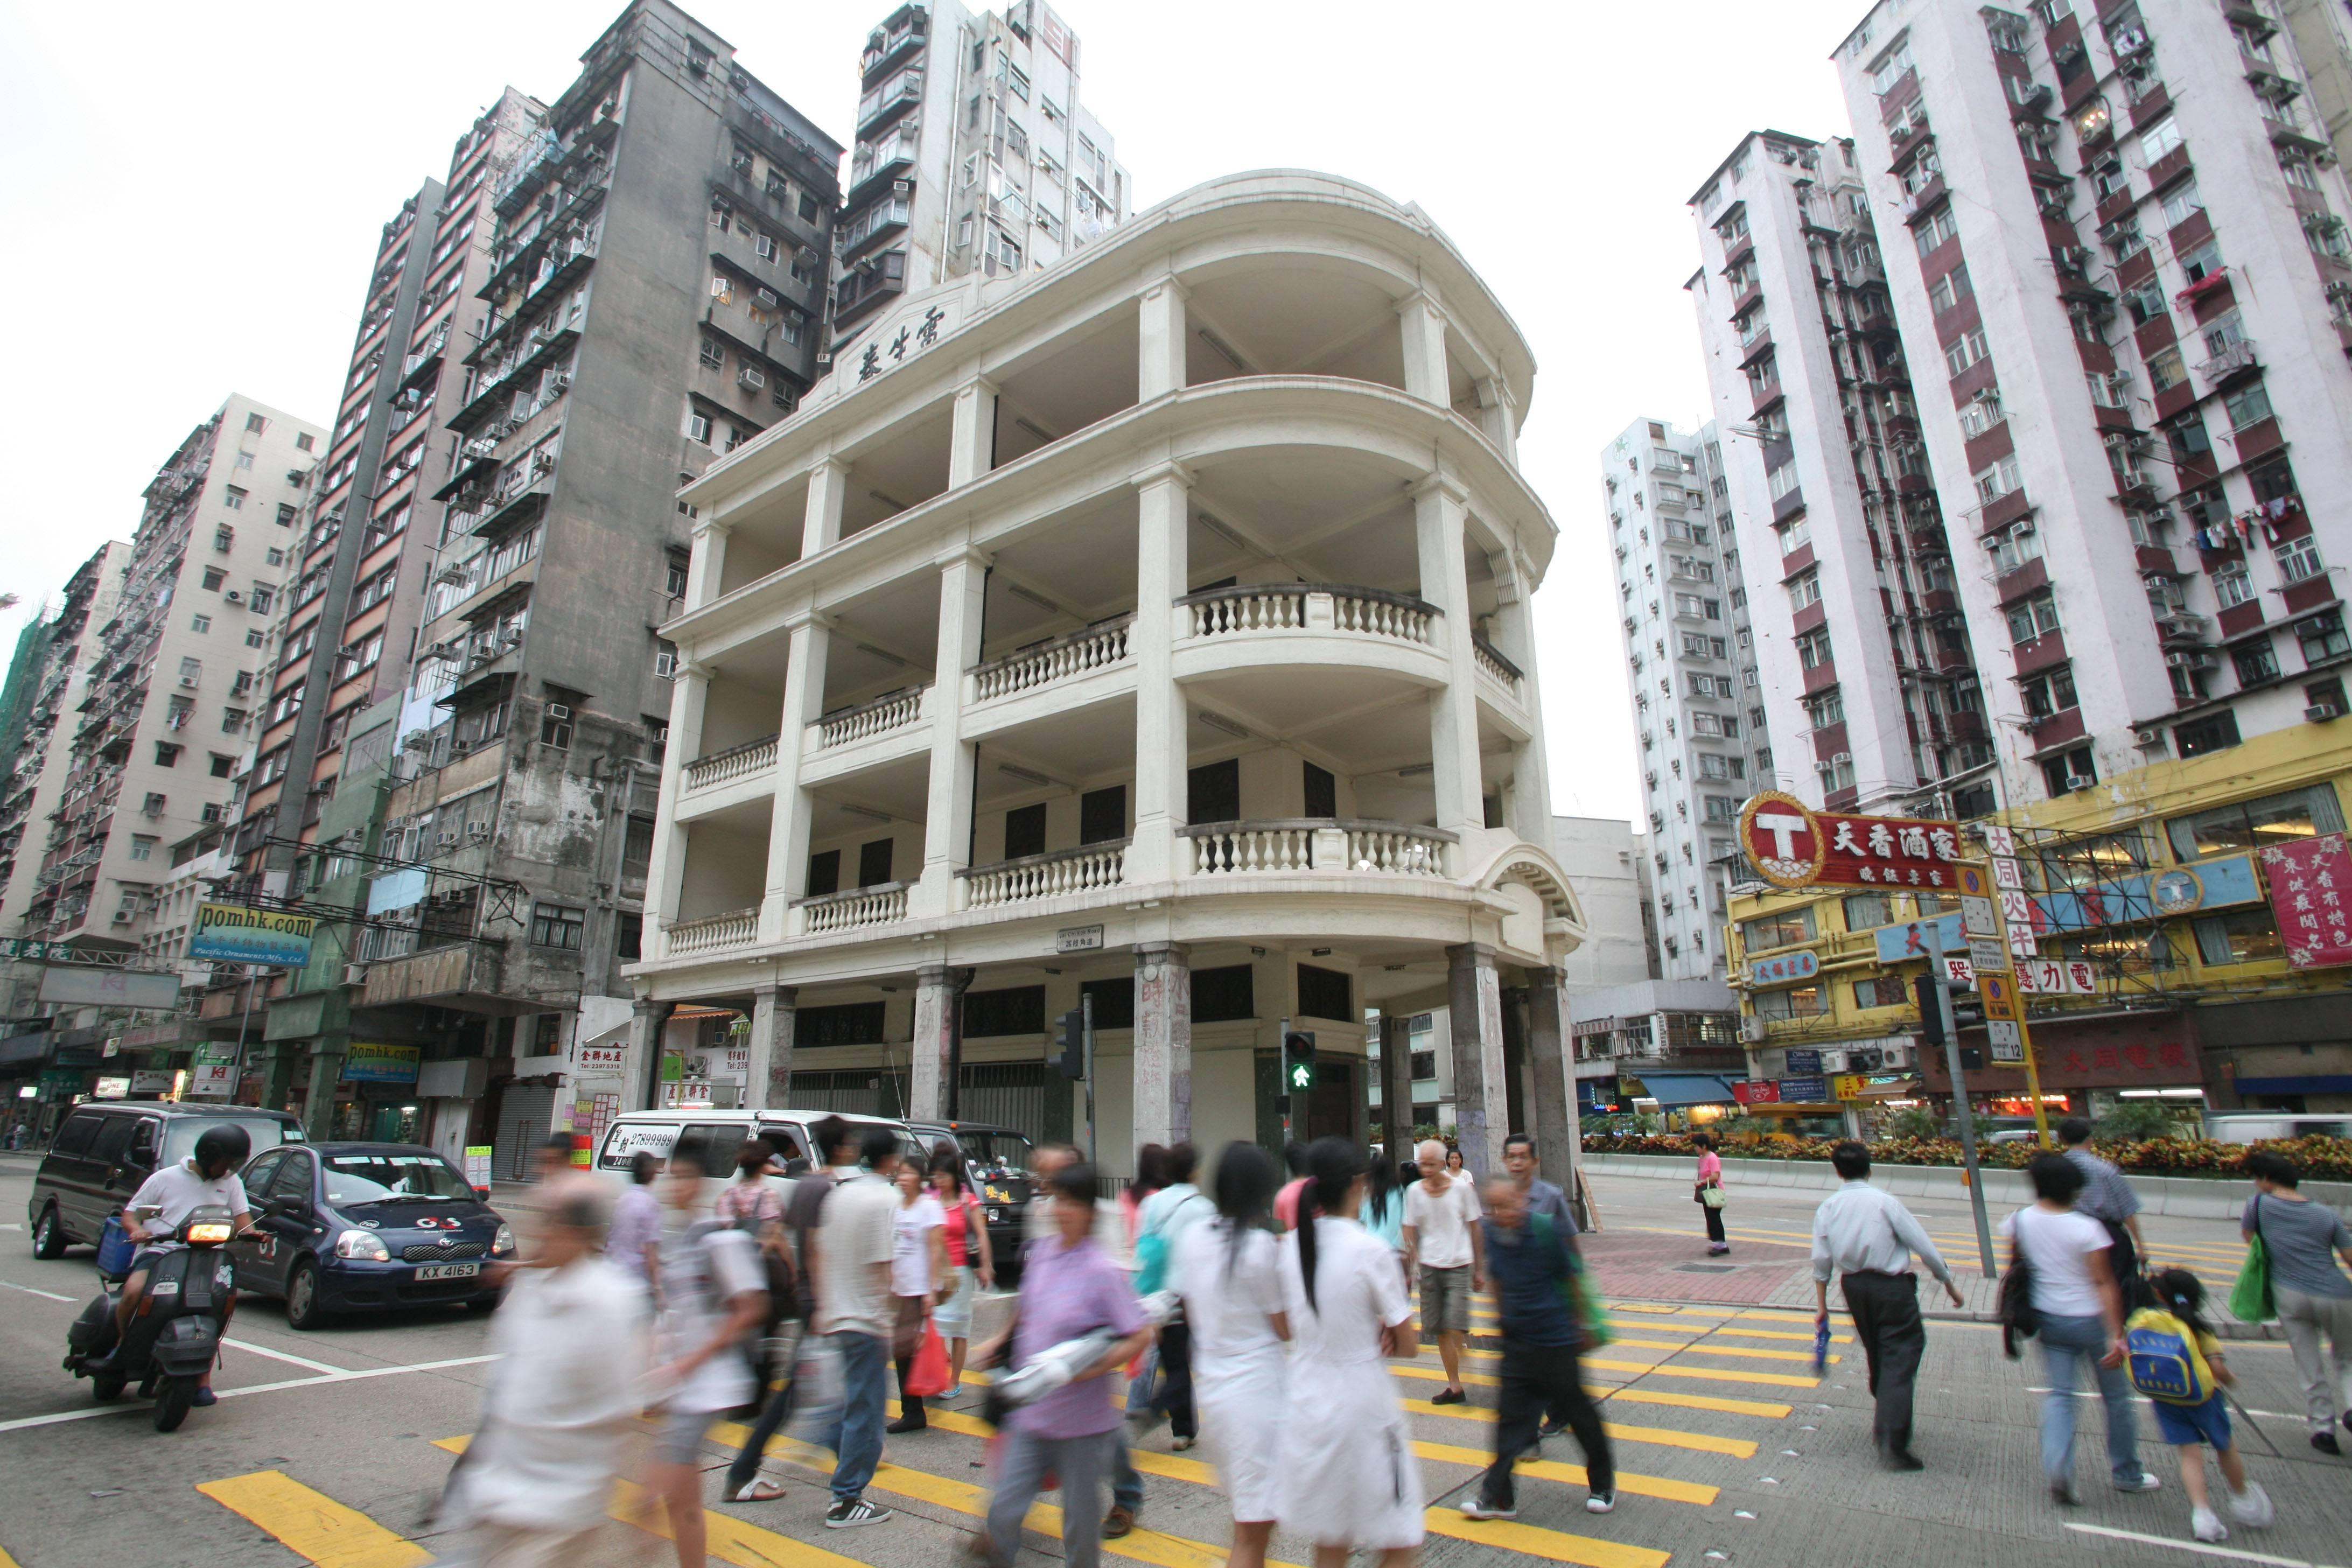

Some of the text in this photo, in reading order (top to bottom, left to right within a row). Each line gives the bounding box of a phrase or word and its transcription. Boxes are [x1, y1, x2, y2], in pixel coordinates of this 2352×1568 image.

[1833, 821, 1959, 862] 天香酒家
[1991, 828, 2032, 955] 大同火牛
[1981, 900, 1986, 911] 7
[198, 907, 312, 938] pomhk.com
[1985, 917, 1989, 927] 7
[194, 947, 223, 956] Pacific
[224, 949, 265, 960] Ornaments
[2006, 1024, 2012, 1035] 7
[348, 1046, 417, 1065] pomhk.com
[580, 1050, 621, 1061] 金聯地產
[2011, 1044, 2021, 1058] 12
[630, 1133, 673, 1146] 27899999
[415, 1216, 462, 1230] G4S
[422, 1263, 474, 1279] KX 4163
